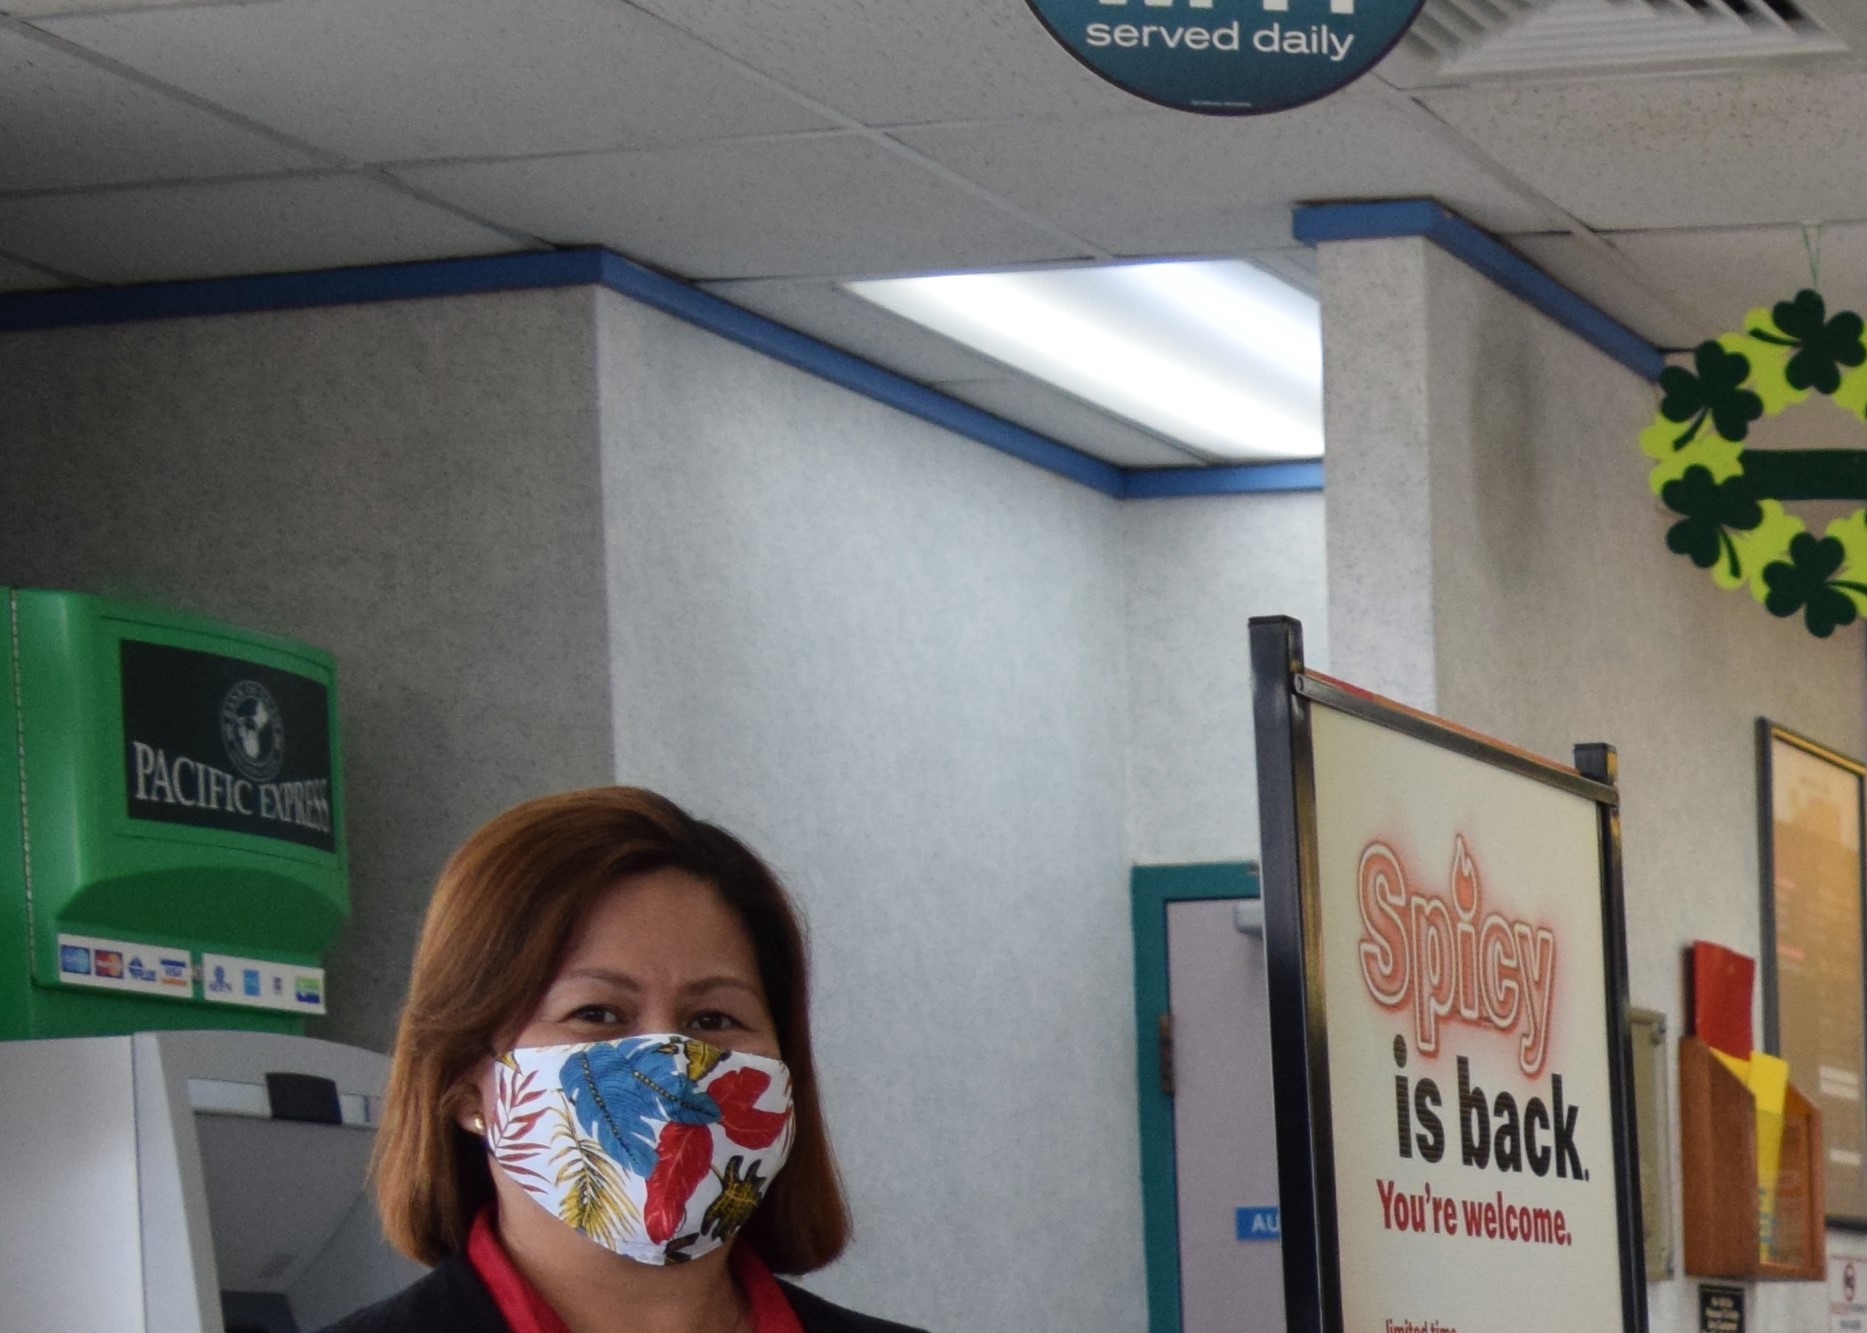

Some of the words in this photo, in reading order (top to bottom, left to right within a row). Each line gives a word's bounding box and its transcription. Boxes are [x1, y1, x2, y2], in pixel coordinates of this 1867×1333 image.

[1086, 21, 1240, 51] served
[1252, 23, 1354, 62] daily
[132, 741, 254, 816] PACIFIC
[259, 778, 331, 833] EXPRESS
[1357, 833, 1557, 1077] Spicy
[1393, 1034, 1446, 1165] is
[1455, 1054, 1590, 1183] back.
[1376, 1178, 1458, 1236] You're
[1462, 1191, 1573, 1247] welcome.
